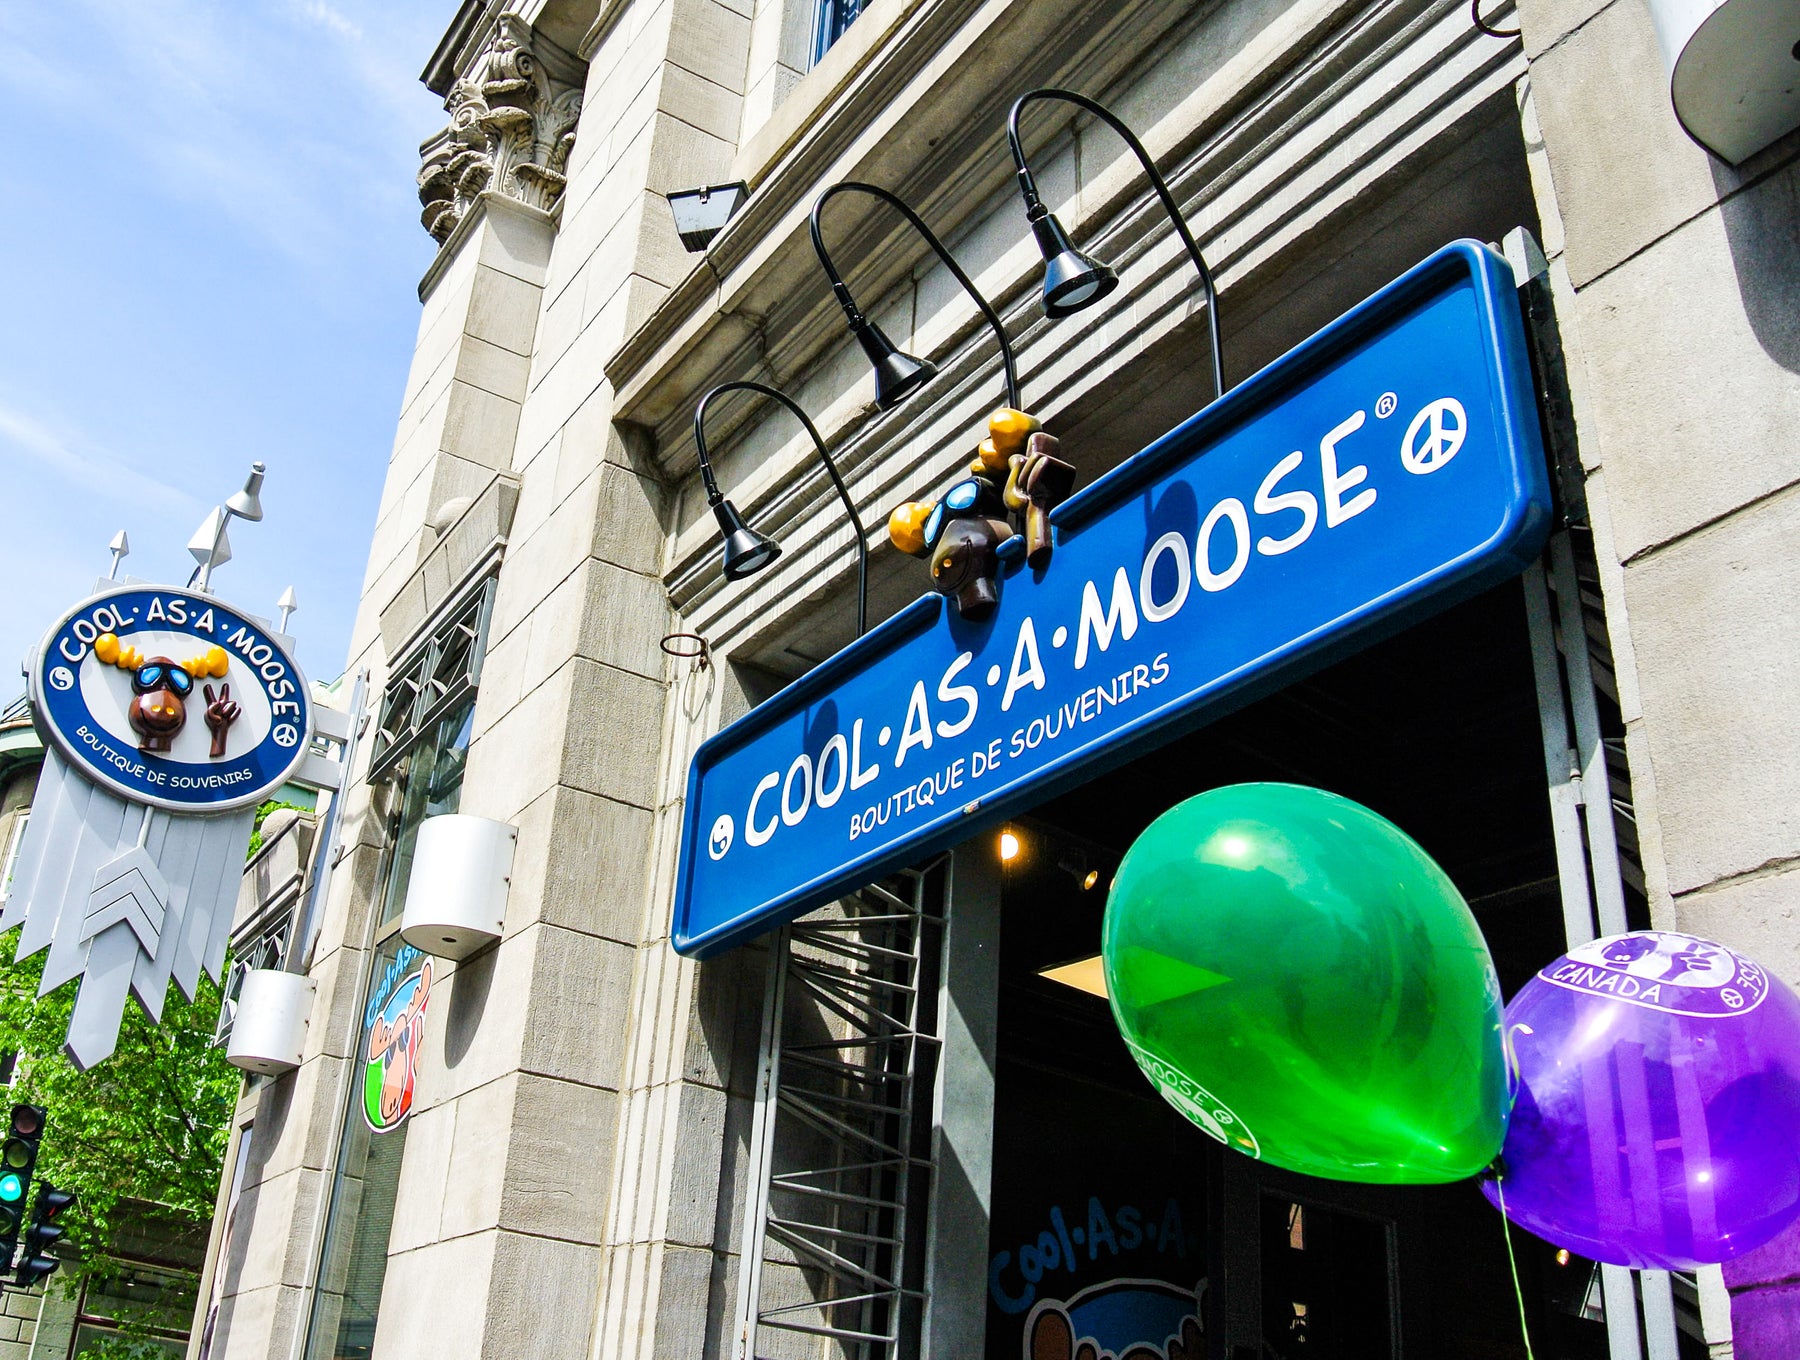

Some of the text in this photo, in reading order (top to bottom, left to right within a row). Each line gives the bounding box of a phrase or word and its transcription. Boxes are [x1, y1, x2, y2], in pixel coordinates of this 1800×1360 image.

[75, 725, 253, 789] BOUTIQUE DE SOUVENIRS
[848, 652, 1171, 842] BOUTIQUE DE SOUVENIRS
[1552, 963, 1663, 1004] CANADA
